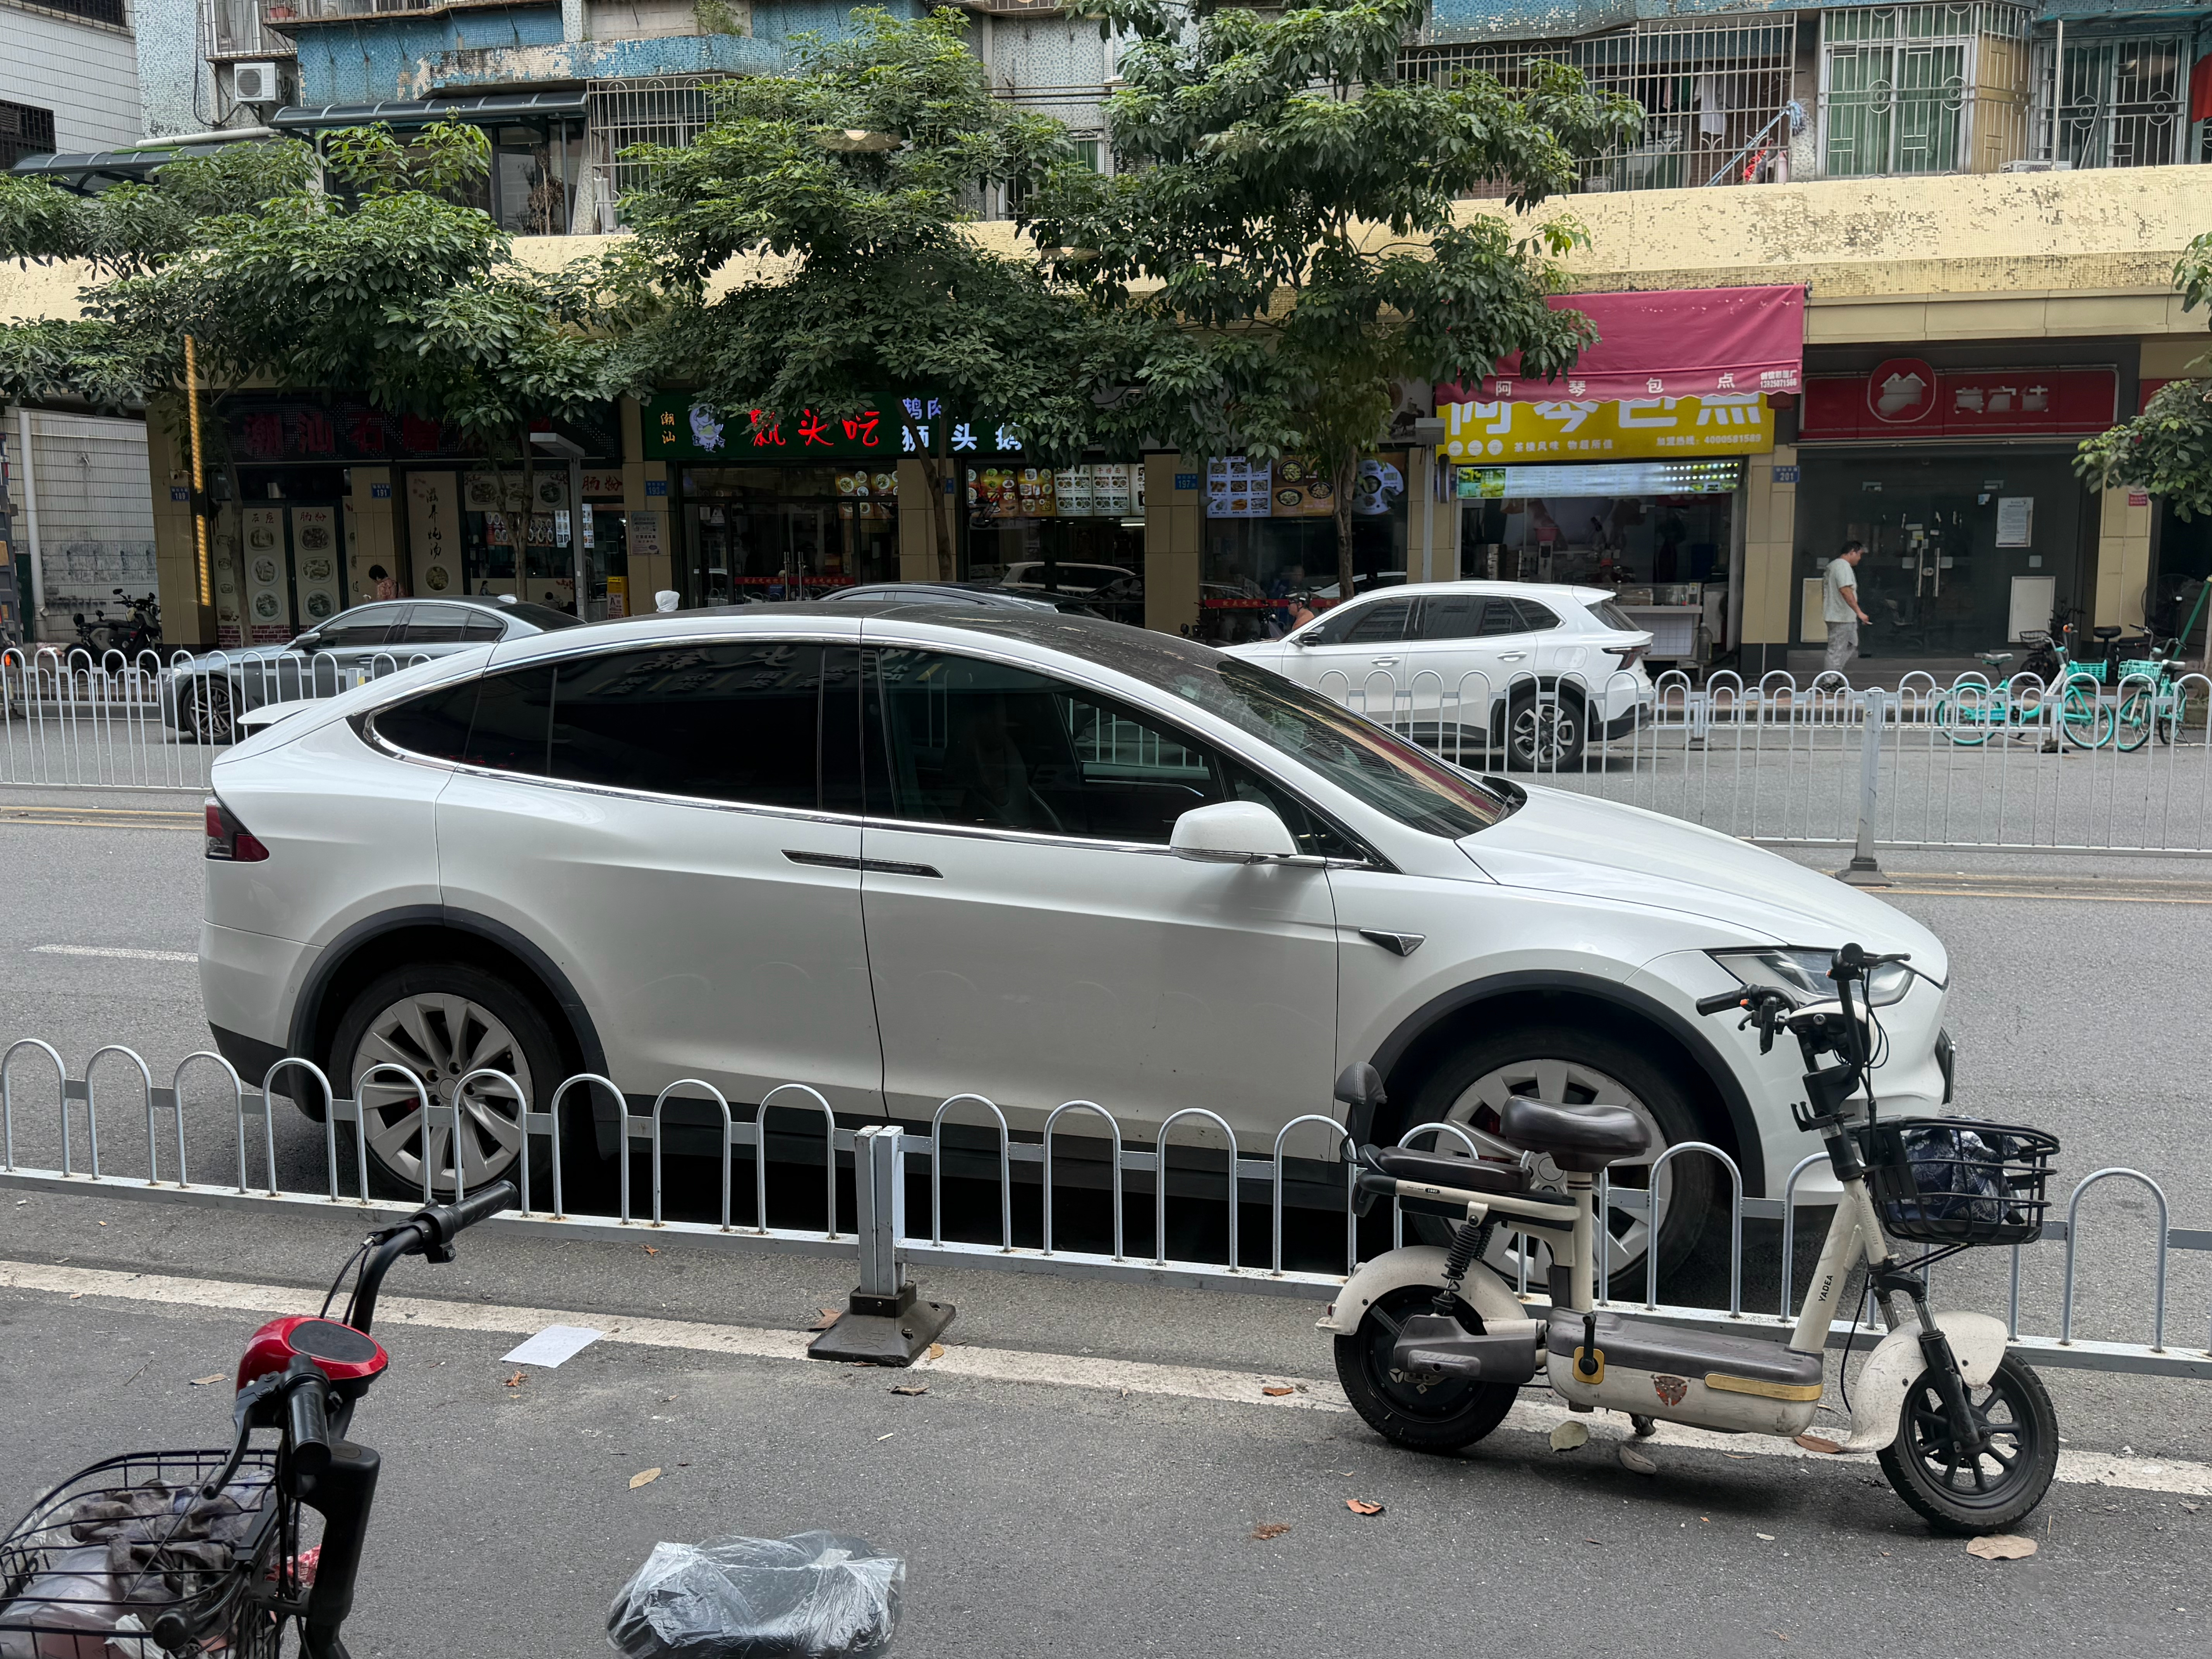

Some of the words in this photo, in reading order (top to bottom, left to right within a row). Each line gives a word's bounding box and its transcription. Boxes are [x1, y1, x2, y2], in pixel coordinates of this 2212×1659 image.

[1496, 372, 1735, 397] 阿琴包点
[661, 411, 675, 444] 潮汕
[1178, 480, 1190, 488] 197
[1780, 472, 1794, 481] 201
[649, 486, 660, 495] 193
[1818, 1275, 1834, 1301] YADEA
